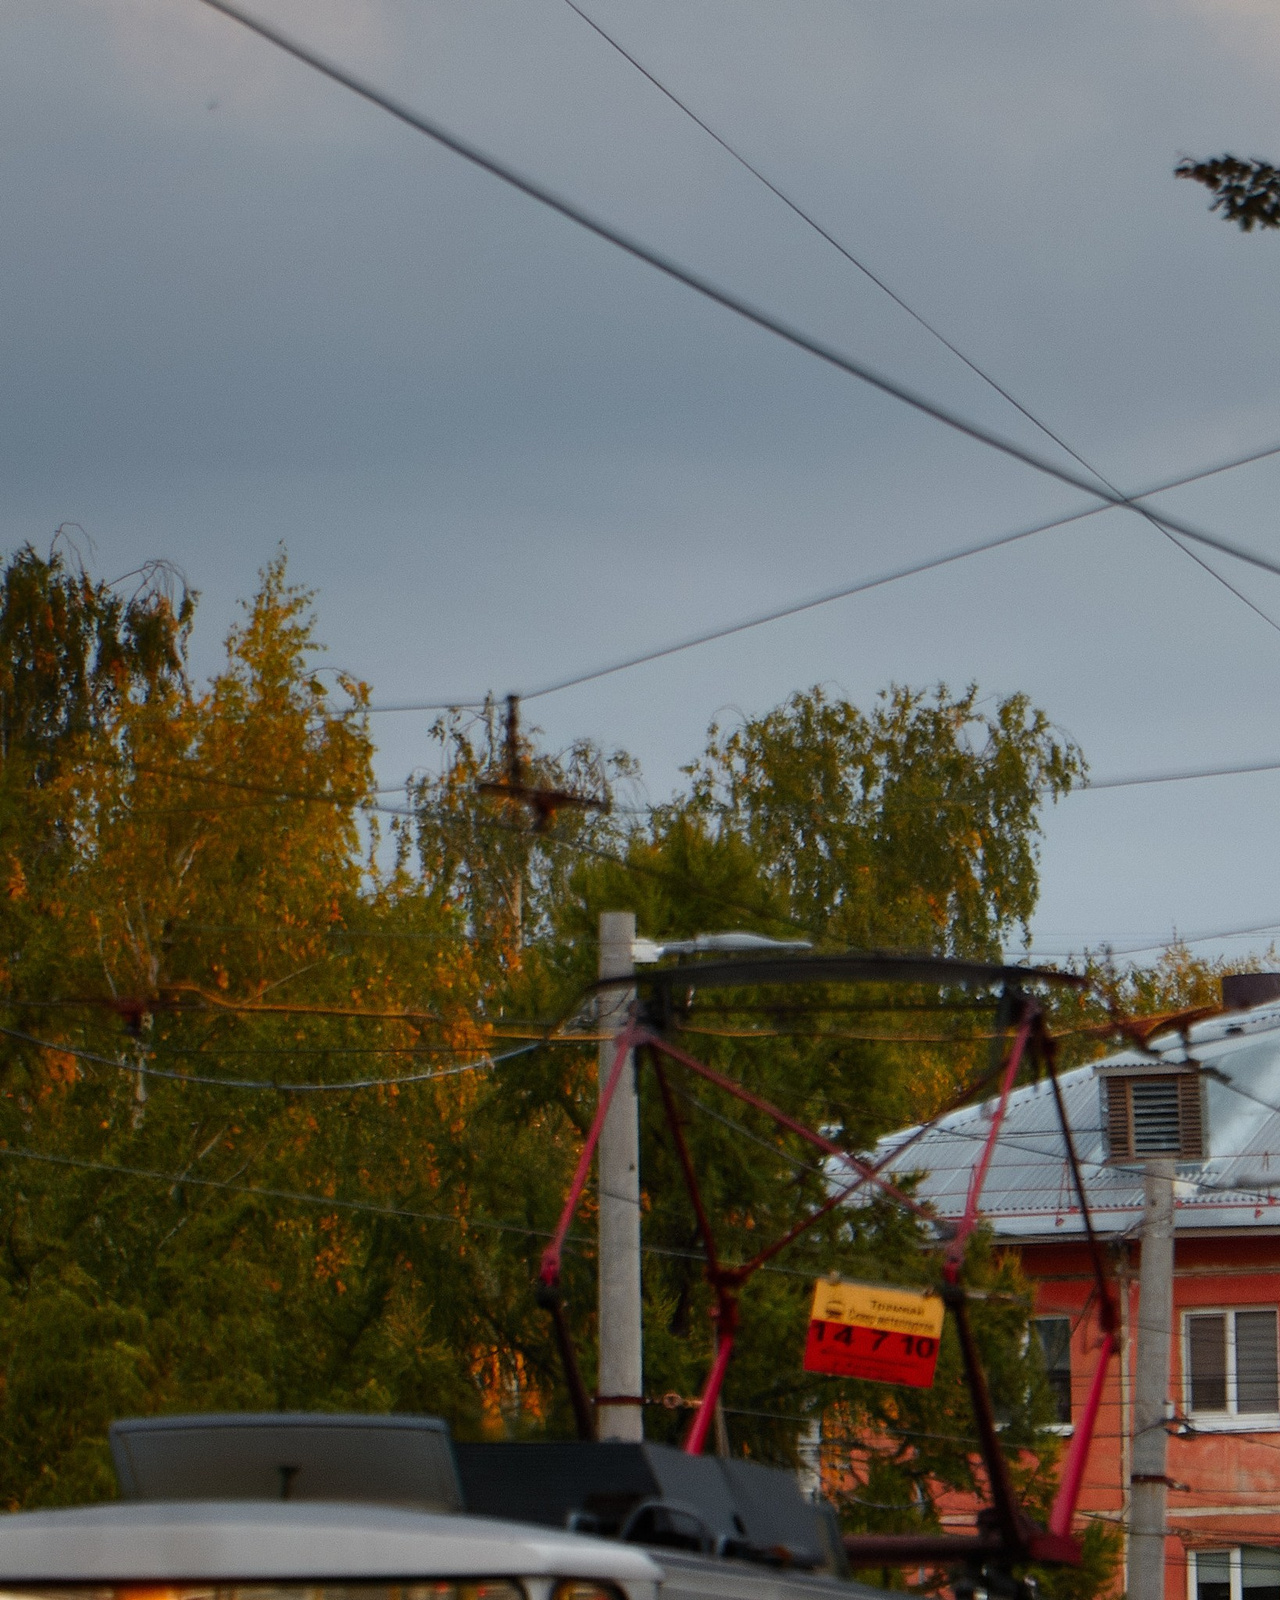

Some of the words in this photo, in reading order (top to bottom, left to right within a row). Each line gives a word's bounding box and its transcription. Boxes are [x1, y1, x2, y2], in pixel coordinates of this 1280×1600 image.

[815, 1321, 826, 1342] 1
[834, 1325, 854, 1346] 4
[871, 1329, 889, 1351] 7
[901, 1334, 935, 1359] 10
